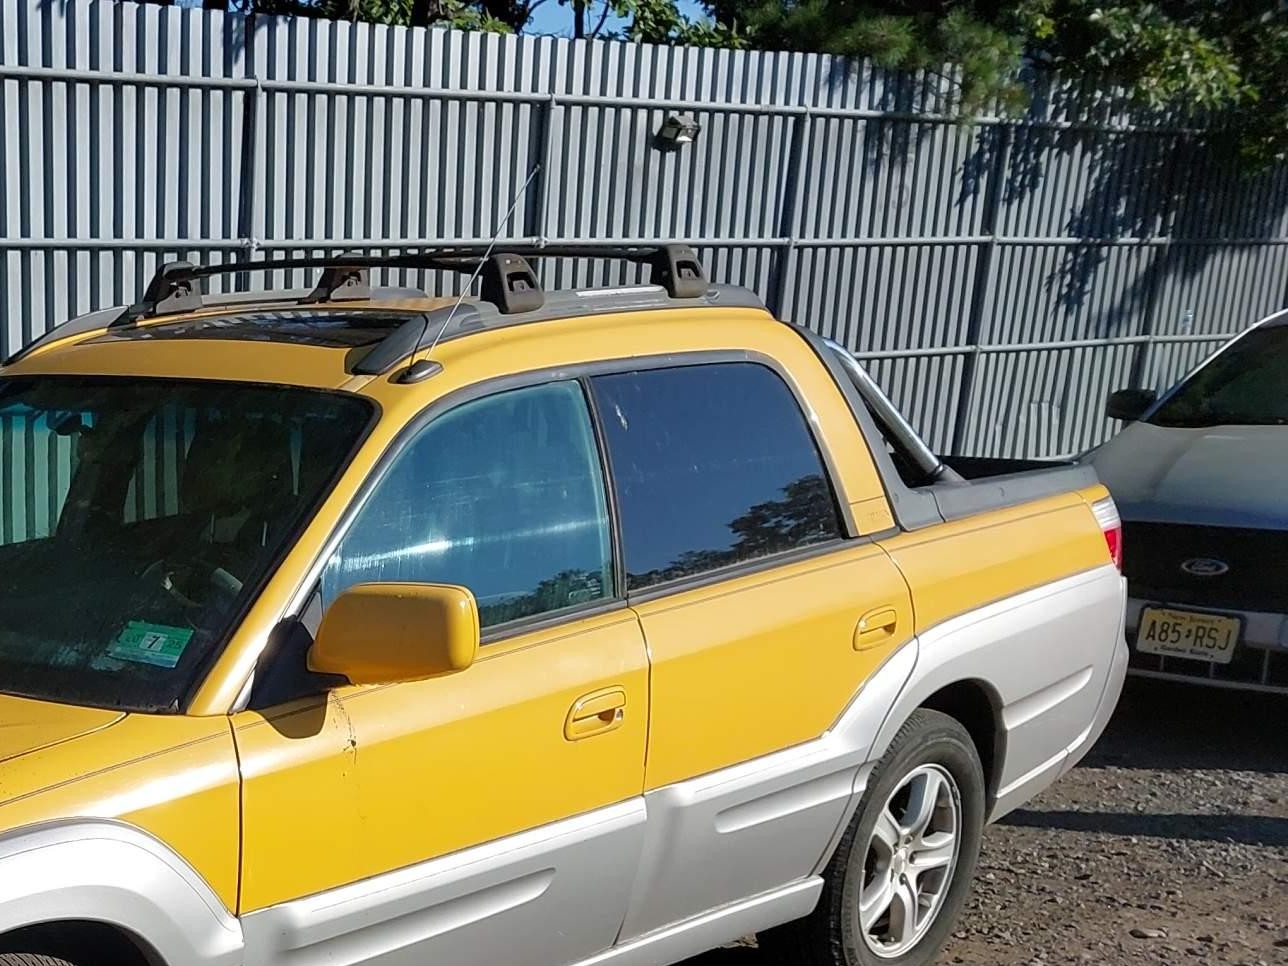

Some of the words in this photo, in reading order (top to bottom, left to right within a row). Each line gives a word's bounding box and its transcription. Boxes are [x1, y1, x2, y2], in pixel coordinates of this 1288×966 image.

[147, 635, 161, 649] 7
[1145, 620, 1182, 644] A85
[1193, 626, 1232, 650] RSJ
